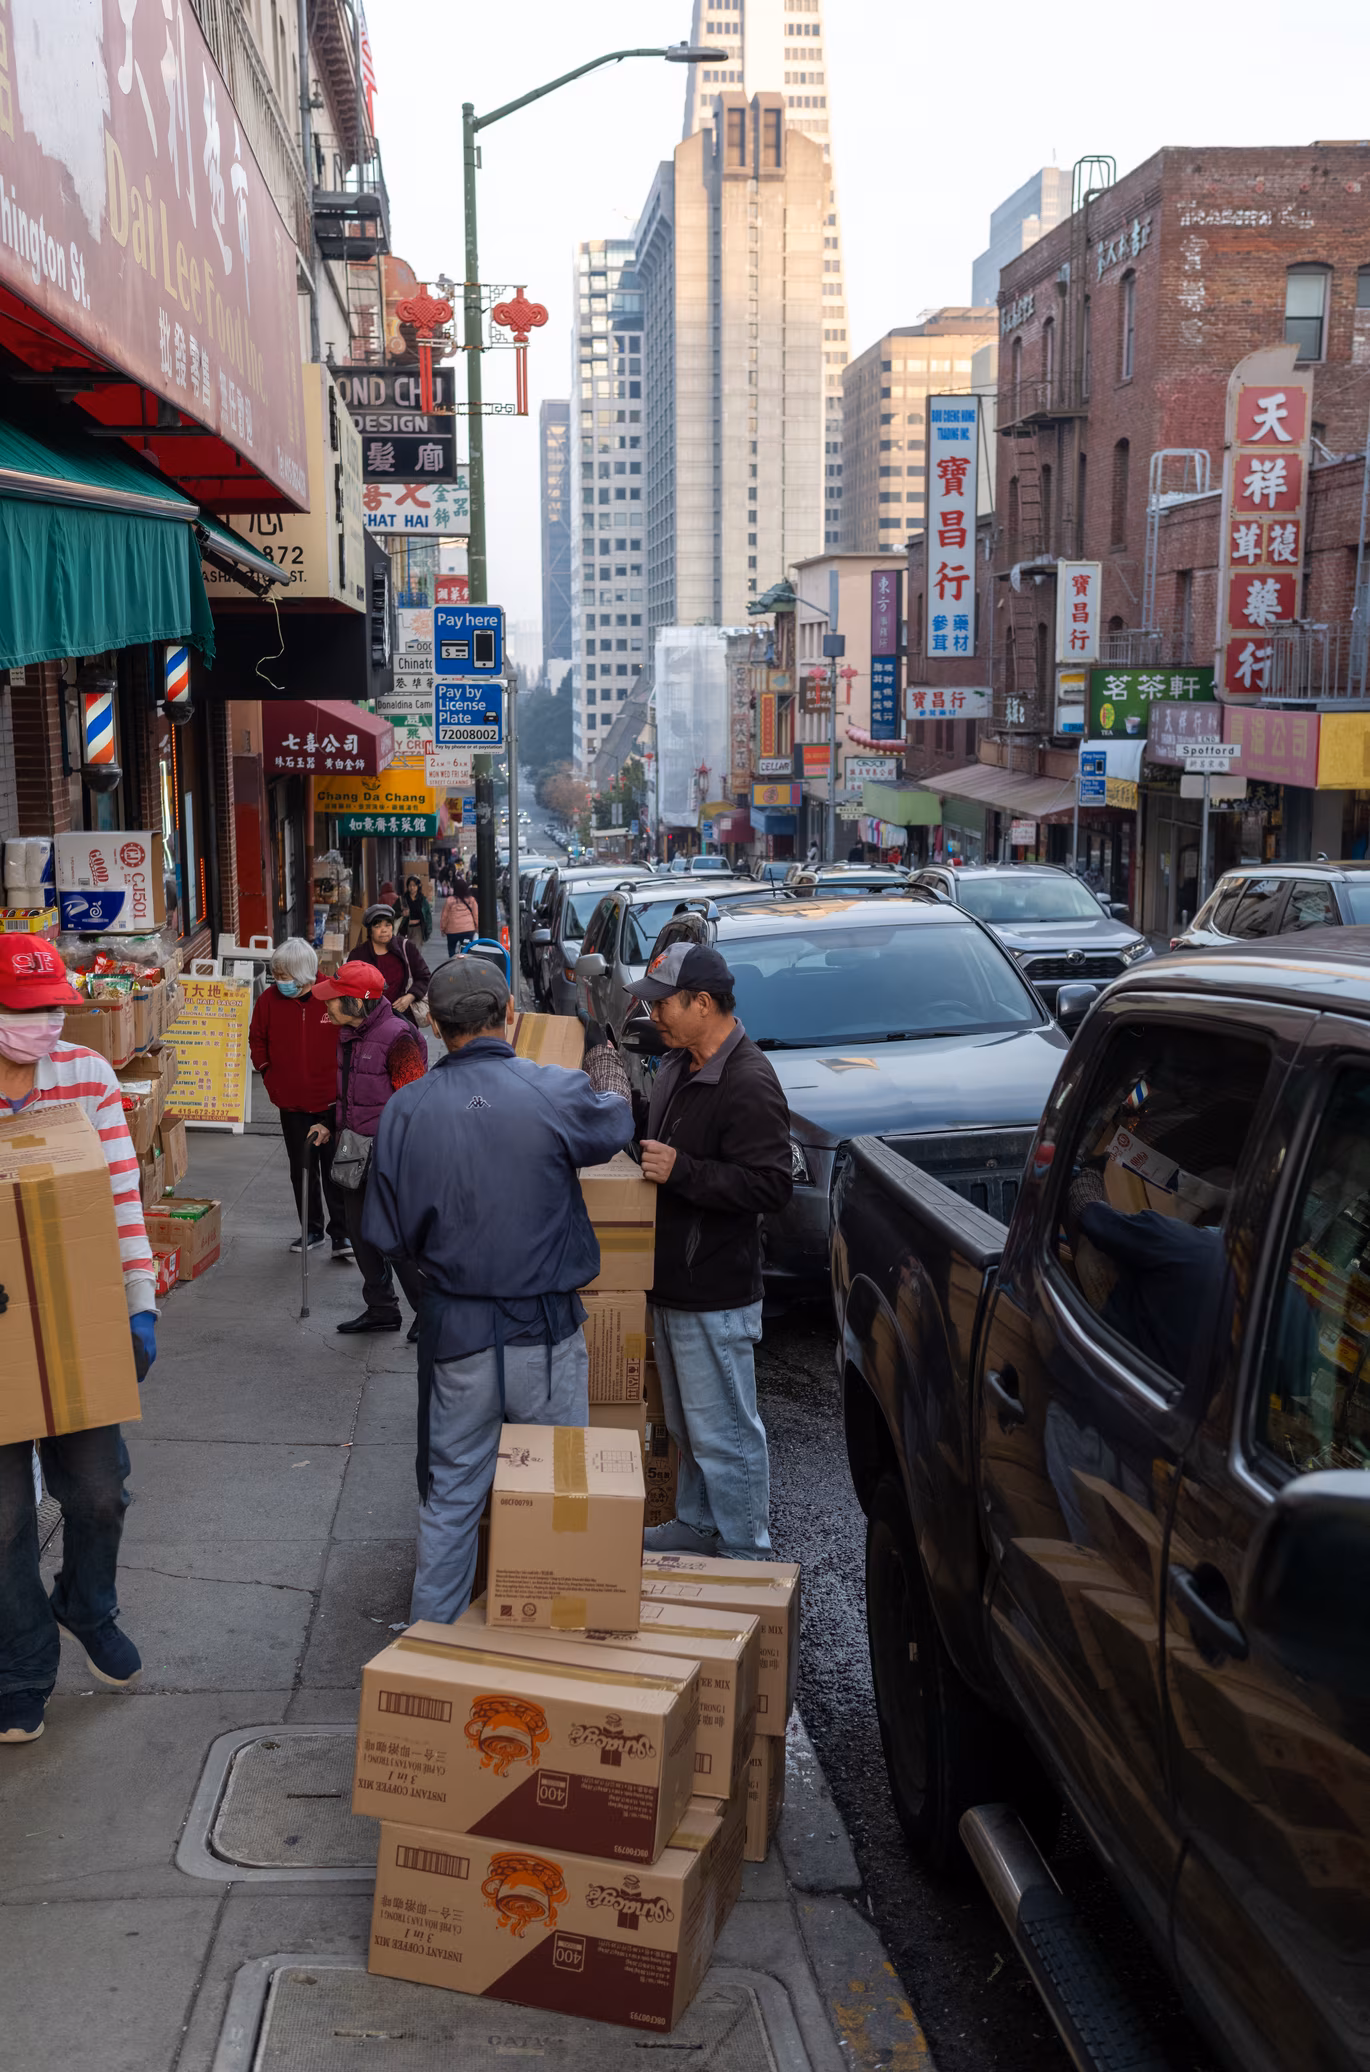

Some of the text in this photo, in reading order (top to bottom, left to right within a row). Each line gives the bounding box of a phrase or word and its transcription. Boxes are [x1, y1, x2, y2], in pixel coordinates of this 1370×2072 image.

[105, 131, 156, 280] Dai
[160, 199, 202, 325] Lee
[204, 257, 245, 377] Food
[70, 241, 91, 311] St.
[405, 515, 429, 528] HAI
[933, 455, 971, 601] 寶昌行
[290, 570, 307, 582] ST.
[1069, 574, 1092, 651] 寶昌行
[437, 613, 498, 629] Pay here
[438, 685, 482, 700] Pay by
[377, 700, 413, 710] Donaldina
[439, 699, 486, 711] License
[440, 711, 471, 724] Plate
[441, 730, 497, 740] 72008002
[282, 732, 358, 754] 七喜公司
[1183, 745, 1234, 756] Spofford
[761, 762, 789, 772] CELLAR
[460, 770, 469, 778] SAT
[318, 791, 426, 804] Chang Da Chang
[89, 849, 109, 883] GOOD
[132, 872, 147, 919] CJ501
[197, 998, 215, 1006] HAIR
[768, 1625, 783, 1635] MIX
[714, 1679, 730, 1690] MIX
[368, 1753, 390, 1767] TRONG
[394, 1759, 408, 1770] TAN
[388, 1770, 418, 1785] 3 in 1
[358, 1778, 447, 1803] INSTANT COFFEE MIX
[540, 1786, 565, 1801] 400
[384, 1911, 406, 1923] TRONG
[411, 1916, 423, 1926] TAN
[404, 1928, 434, 1944] 3 in 1
[374, 1935, 463, 1963] INSTANT COFFEE MIX
[556, 1948, 581, 1964] 400
